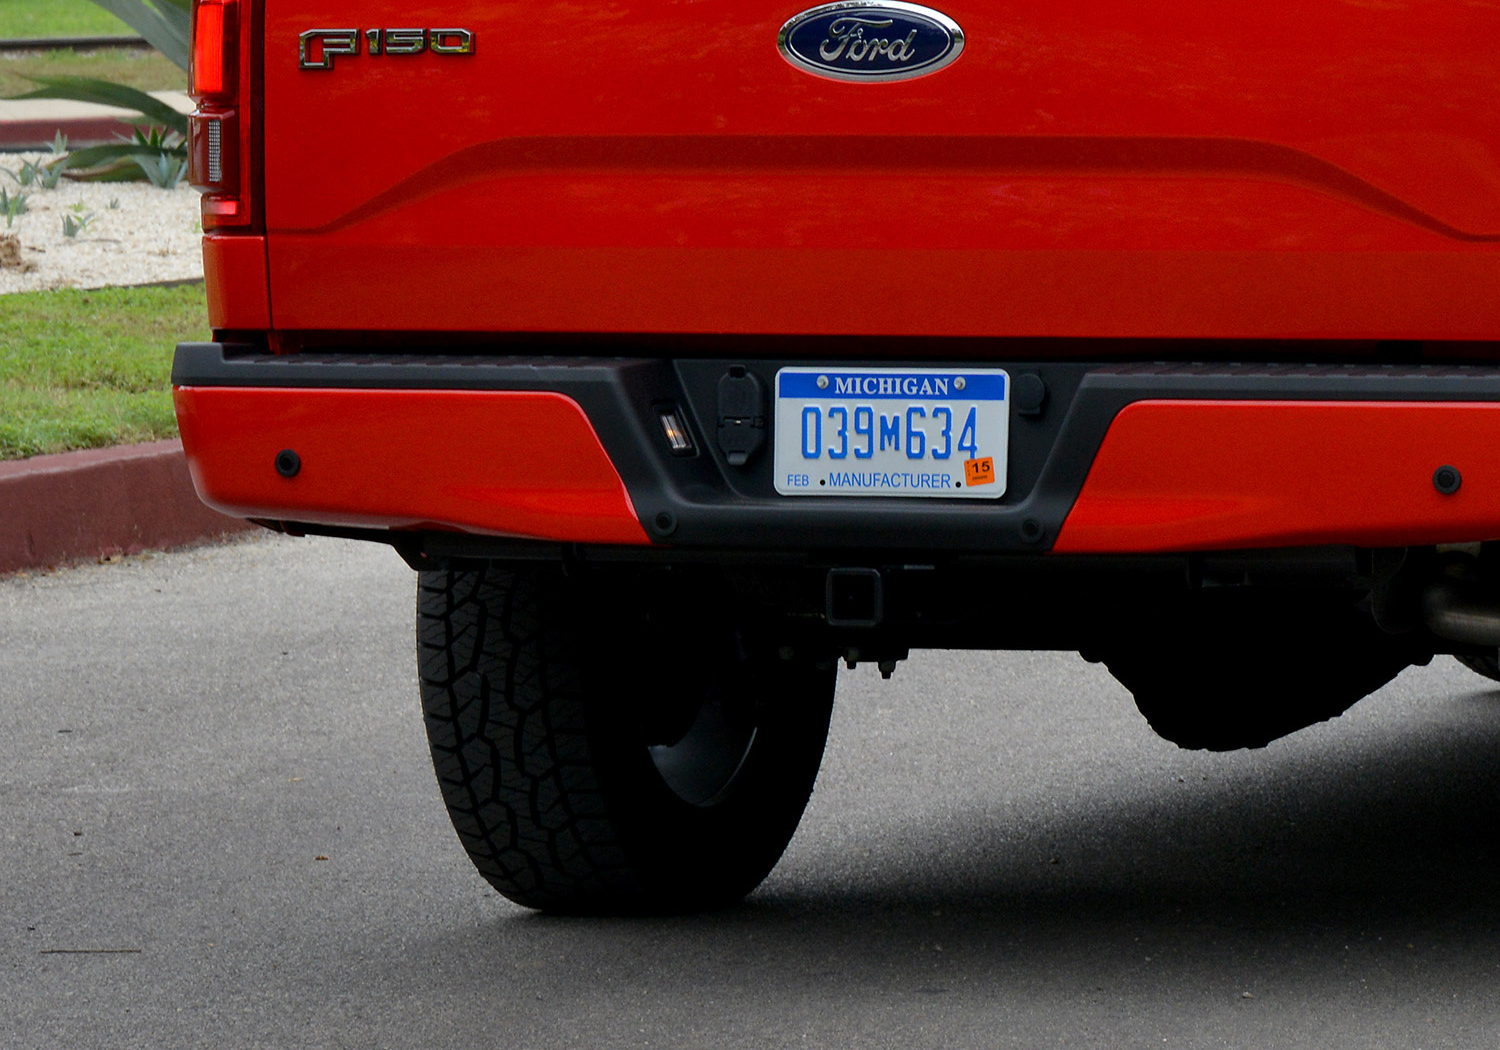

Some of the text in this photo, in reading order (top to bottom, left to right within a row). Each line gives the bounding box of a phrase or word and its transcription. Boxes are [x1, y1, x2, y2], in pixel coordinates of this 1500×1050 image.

[299, 28, 475, 69] F150
[818, 16, 918, 62] Ford
[834, 377, 949, 396] MICHIGAN
[801, 406, 978, 460] 039M634
[787, 473, 951, 488] FEB MANUFACTURER
[972, 461, 990, 474] 15
